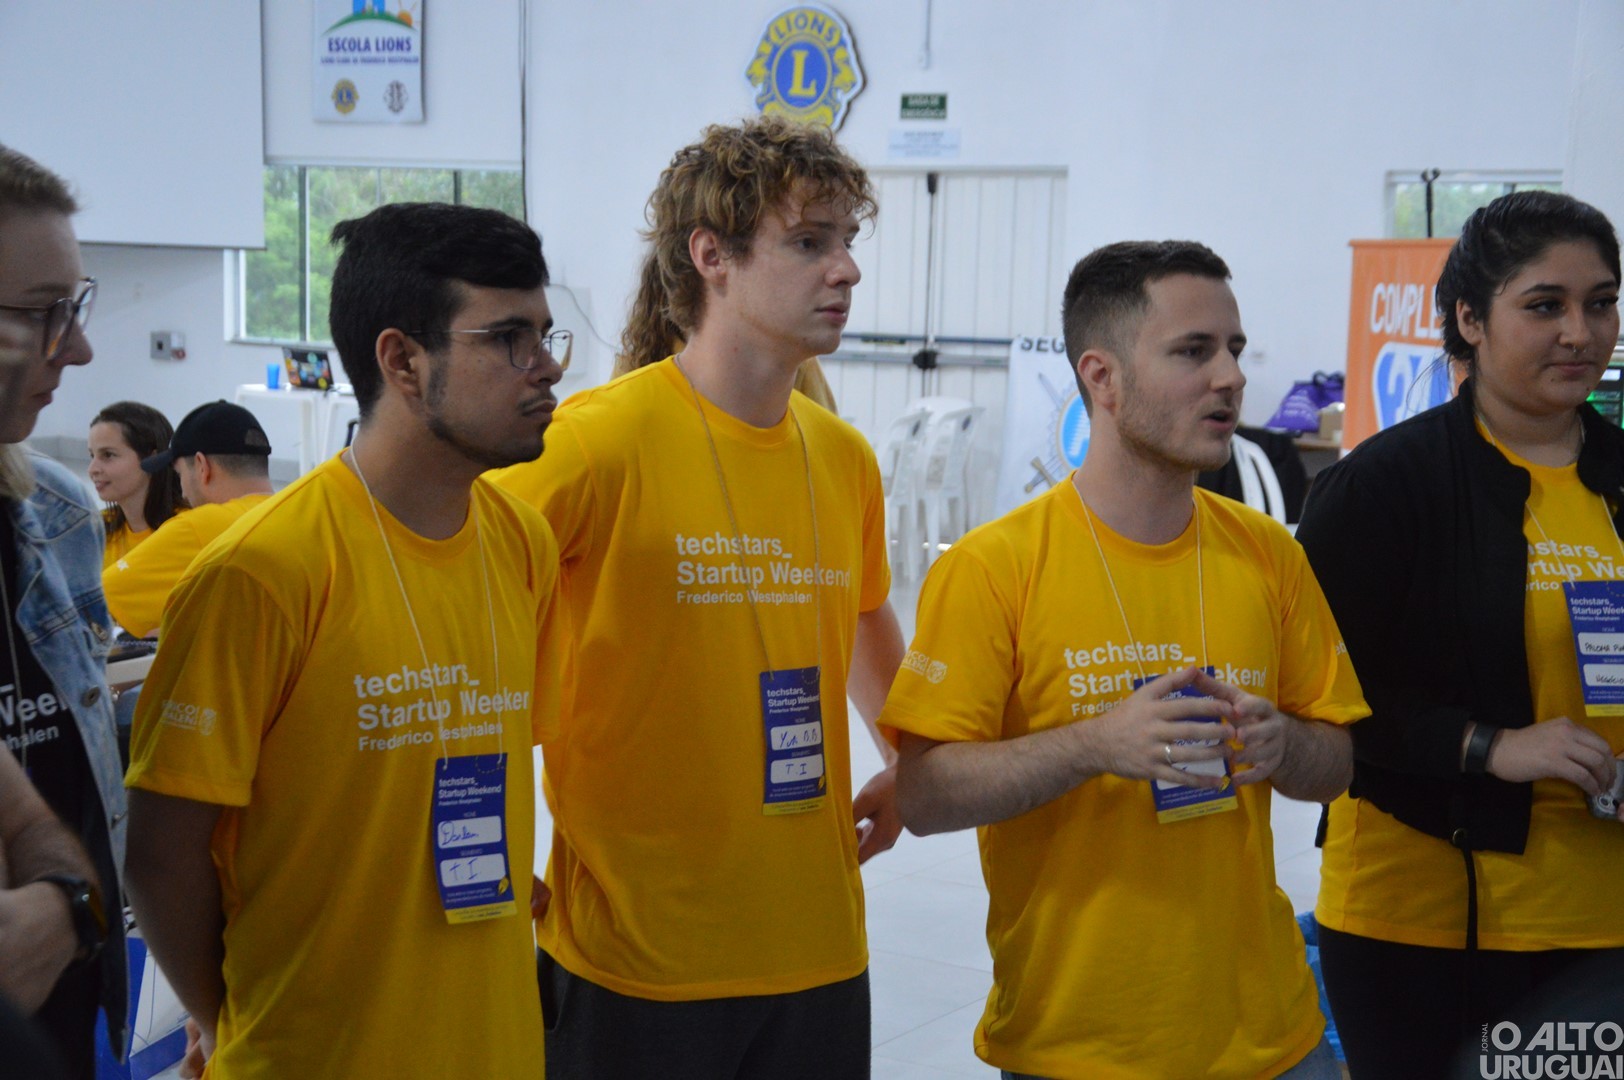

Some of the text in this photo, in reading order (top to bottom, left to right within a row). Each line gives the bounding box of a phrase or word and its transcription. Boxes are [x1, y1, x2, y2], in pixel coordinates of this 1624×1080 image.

[774, 11, 837, 43] LIONS
[328, 36, 411, 53] ESCOLA LIONS
[787, 49, 818, 97] L
[675, 531, 793, 559] techstars_
[677, 561, 765, 588] Startup
[676, 589, 812, 606] Frederico Westphalen
[1572, 606, 1602, 616] Startup
[1064, 640, 1197, 669] techstars_
[354, 663, 481, 699] techstars_
[358, 698, 451, 731] Startup
[768, 697, 797, 708] Startup
[358, 730, 434, 752] Frederico
